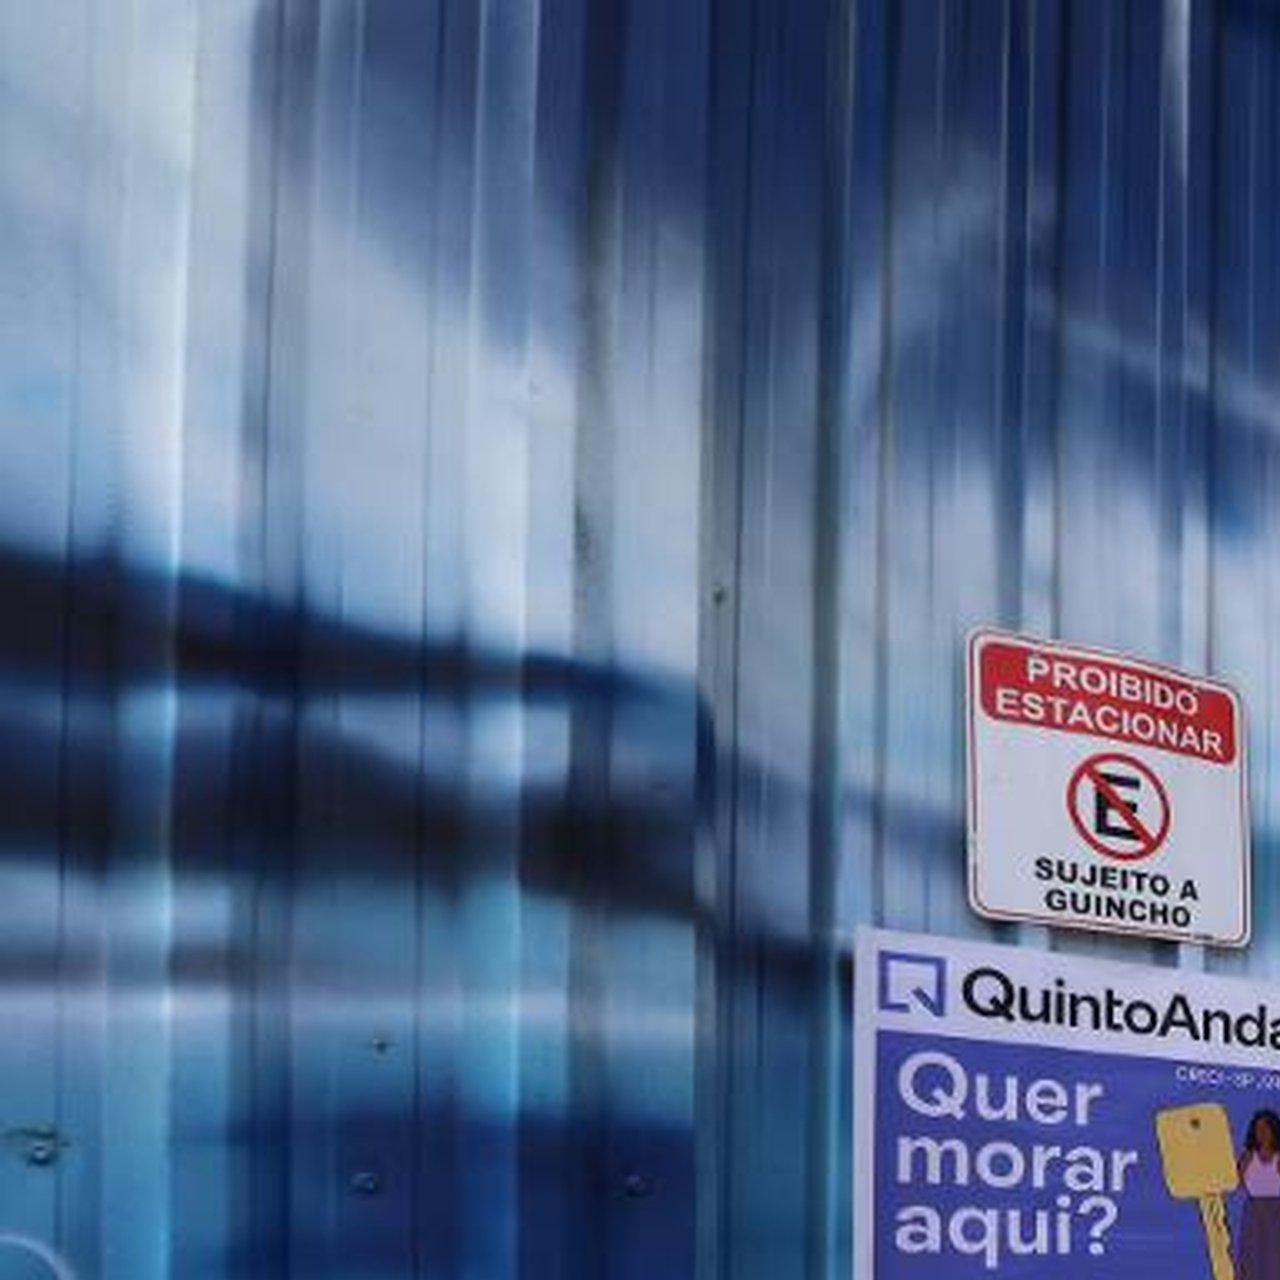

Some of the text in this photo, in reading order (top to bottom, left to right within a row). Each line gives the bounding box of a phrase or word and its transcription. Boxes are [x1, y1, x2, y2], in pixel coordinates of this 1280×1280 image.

[1027, 656, 1198, 712] PROIBIDO
[996, 689, 1223, 755] ESTACIONAR
[1035, 857, 1198, 900] SUJEITO A
[1045, 890, 1191, 928] GUINCHO
[899, 1051, 1103, 1126] Quer
[896, 1135, 1138, 1192] morar
[894, 1196, 1119, 1268] aqui?
